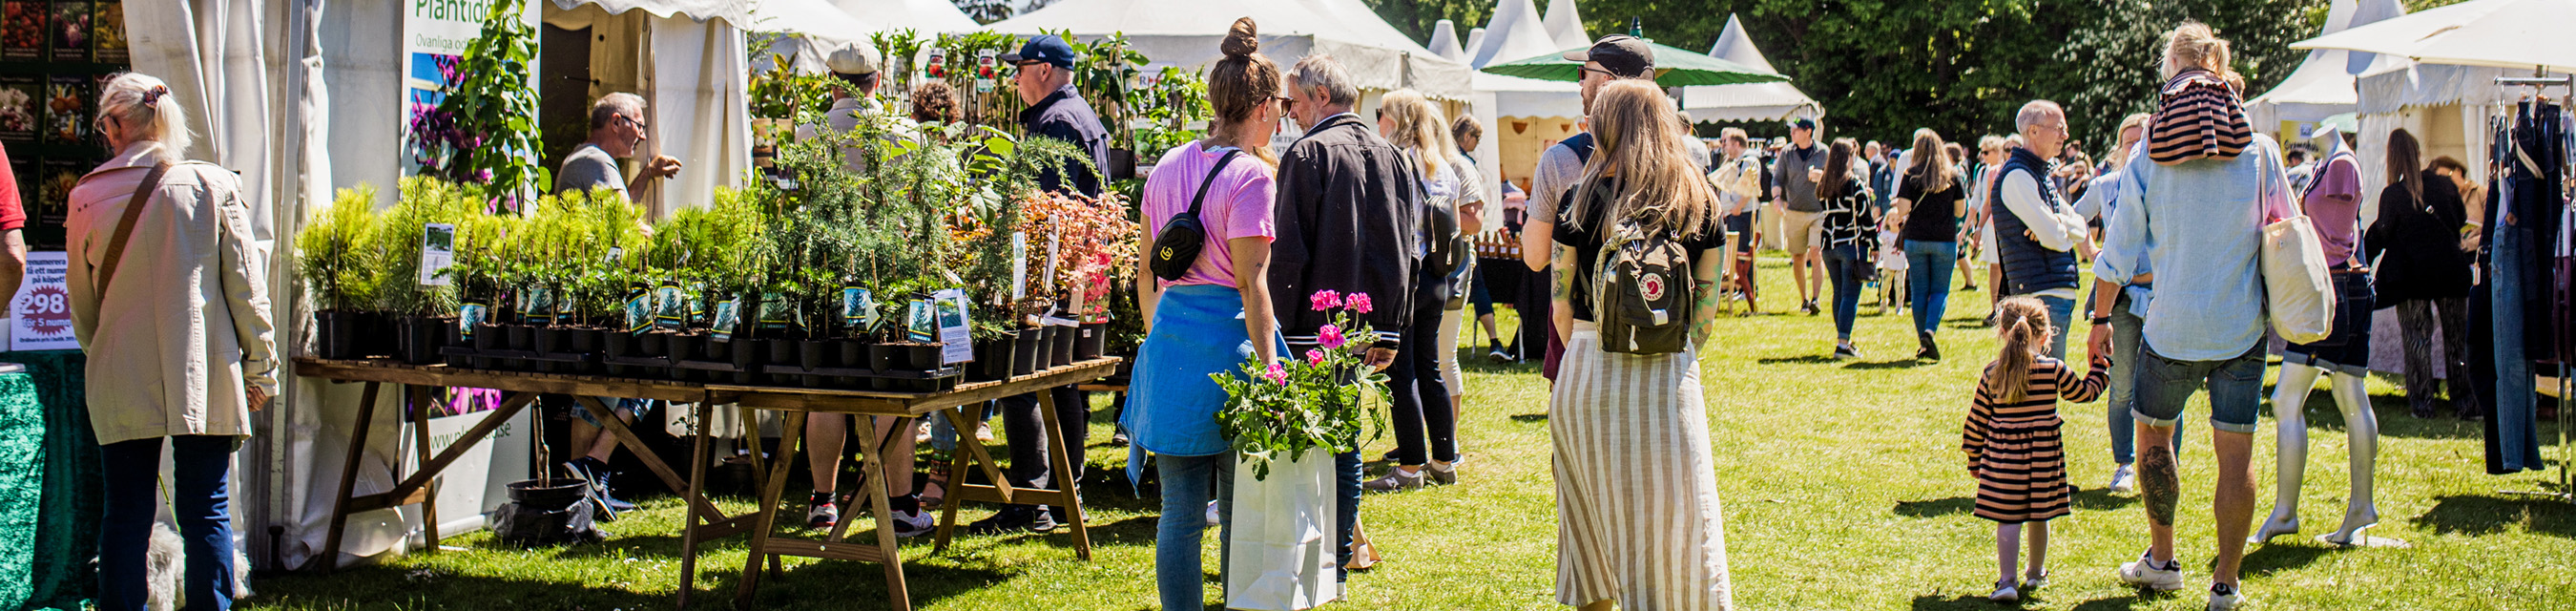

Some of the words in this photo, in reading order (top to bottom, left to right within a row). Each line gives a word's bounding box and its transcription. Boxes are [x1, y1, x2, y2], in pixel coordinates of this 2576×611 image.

[416, 32, 453, 53] Ovanliga
[32, 275, 41, 284] på
[20, 293, 65, 314] 298
[37, 318, 45, 327] 5
